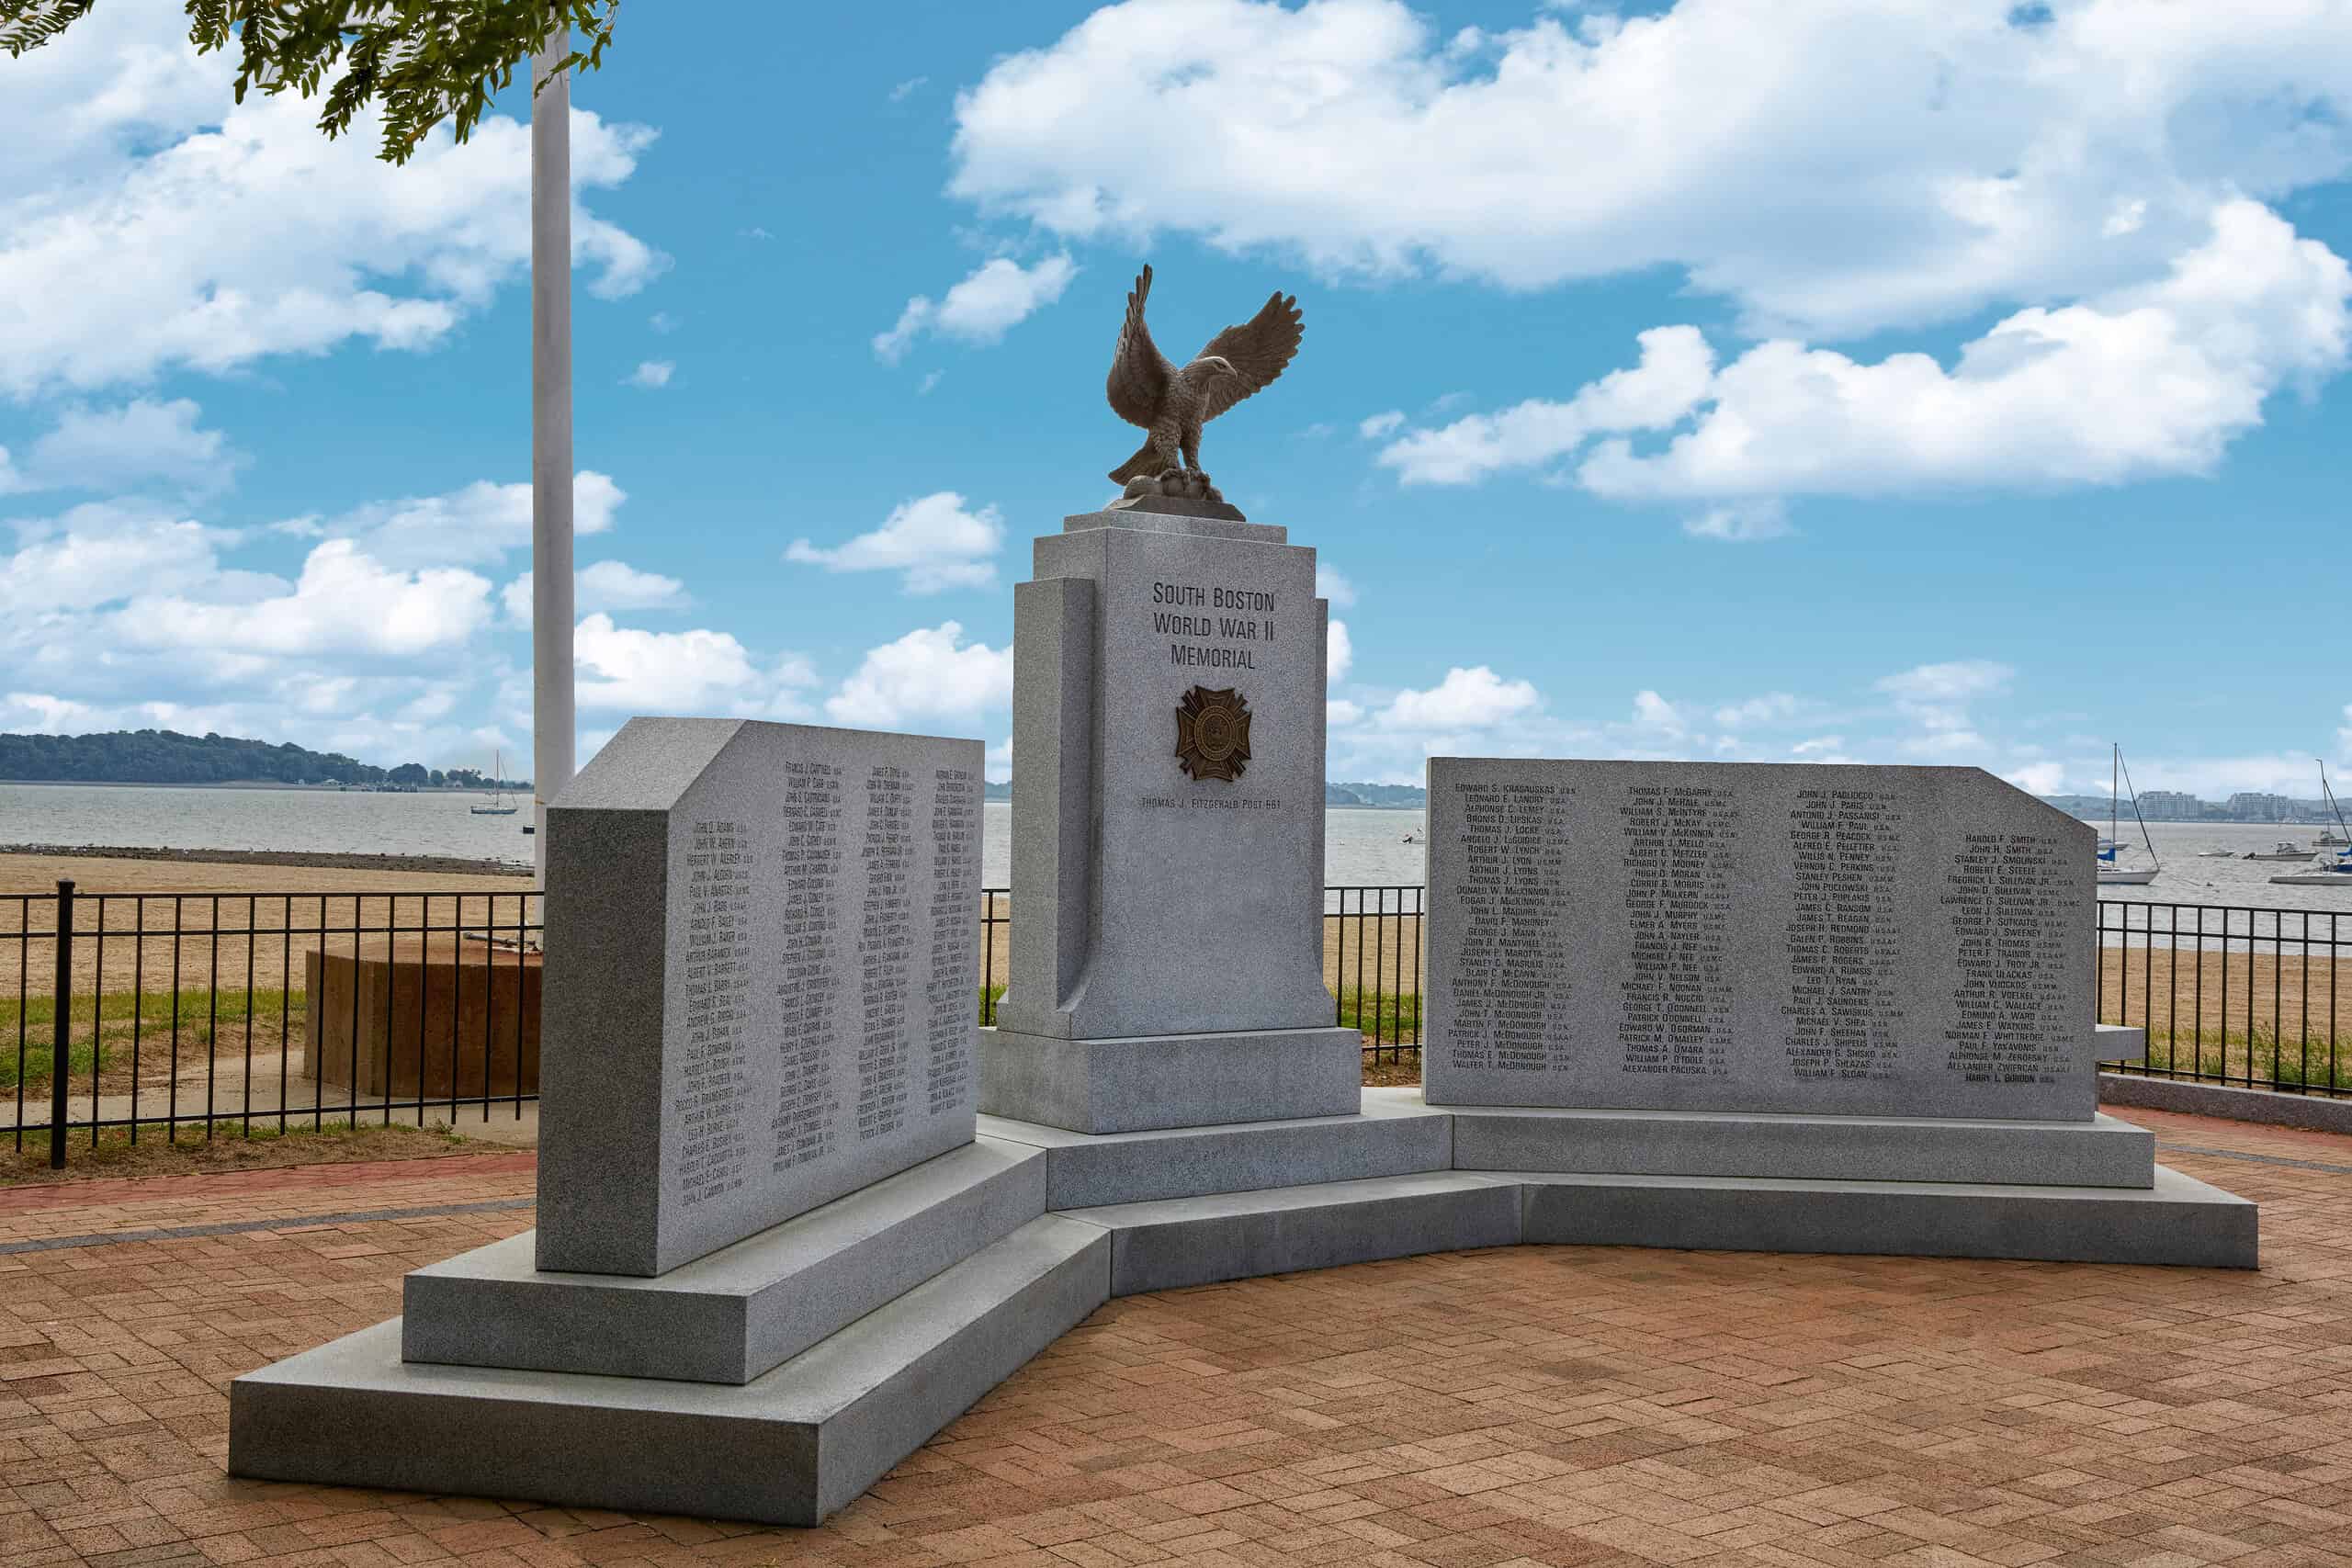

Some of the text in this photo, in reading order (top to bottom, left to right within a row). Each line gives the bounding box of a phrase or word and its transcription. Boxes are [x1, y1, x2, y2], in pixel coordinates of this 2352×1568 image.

[1153, 581, 1274, 612] SOUTH BOSTON
[1153, 612, 1273, 641] WORLD WAR II
[1170, 644, 1256, 670] MEMORIAL
[1141, 797, 1175, 809] THOMAS
[1192, 798, 1238, 809] FITZGERALD
[1242, 799, 1262, 809] POST
[1464, 794, 1499, 802] LEONARD
[1514, 795, 1544, 804] LANDRY
[1634, 797, 1654, 807] JOHN
[1806, 800, 1826, 809] JOHN
[1620, 807, 1654, 817] WILLIAM
[1630, 818, 1660, 827] ROBERT
[1801, 821, 1835, 830] WILLIAM
[1849, 822, 1868, 830] PAUL
[1470, 824, 1501, 833] THOMAS
[1623, 828, 1657, 837] WILLIAM
[1969, 845, 1991, 853] JOHN
[2006, 846, 2031, 854] SMITH
[1467, 855, 1498, 863] ARTHUR
[1512, 856, 1532, 864] LYON
[1839, 852, 1870, 862] PENNEY
[1954, 855, 1987, 863] STANLEY
[1623, 859, 1657, 868] RICHARD
[1793, 862, 1825, 871] VERNON
[1840, 863, 1874, 872] PERKINS
[1469, 865, 1499, 874] ARTHUR
[1513, 866, 1538, 875] LYONS
[1635, 869, 1656, 878] HUGH
[1671, 870, 1701, 878] MORAN
[1963, 865, 1994, 874] ROBERT
[2008, 866, 2036, 874] STEELE
[1626, 889, 1647, 897] JOHN
[1957, 886, 1980, 895] JOHN
[1995, 886, 2031, 895] SULLIVAN
[1940, 896, 1982, 905] LAWRENCE
[1998, 897, 2034, 906] SULLIVAN
[1794, 903, 1822, 912] JAMES
[1838, 903, 1871, 912] RANSOM
[1962, 907, 1982, 915] LEON
[1996, 907, 2033, 916] SULLIVAN
[1630, 910, 1651, 919] JOHN
[1665, 910, 1698, 919] MURPHY
[1468, 927, 1498, 936] GEORGE
[1512, 928, 1536, 937] MANN
[1955, 928, 1989, 936] EDWARD
[2004, 928, 2041, 937] SWEENEY
[1634, 942, 1668, 950] FRANCIS
[1785, 944, 1818, 953] THOMAS
[1958, 948, 1983, 957] PETER
[1634, 962, 1668, 971] WILLIAM
[1682, 963, 1698, 972] NEE
[1957, 958, 1991, 967] EDWARD
[1634, 973, 1655, 982] JOHN
[1669, 974, 1700, 982] NELSON
[1455, 999, 1483, 1008] JAMES
[1792, 996, 1812, 1005] PAUL
[1826, 997, 1869, 1006] SAUNDERS
[1956, 1000, 1989, 1009] WILLIAM
[2005, 1001, 2041, 1010] WALLACE
[1962, 1010, 1996, 1019] EDMUND
[2010, 1011, 2035, 1021] WARD
[1796, 1017, 1830, 1026] MICHAEL
[1845, 1018, 1866, 1027] SHEA
[1956, 1021, 1983, 1030] JAMES
[1448, 1029, 1479, 1038] PATRICK
[1457, 1039, 1480, 1048] PETER
[1453, 1060, 1484, 1069] WALTER
[1623, 1065, 1668, 1074] ALEXANDER
